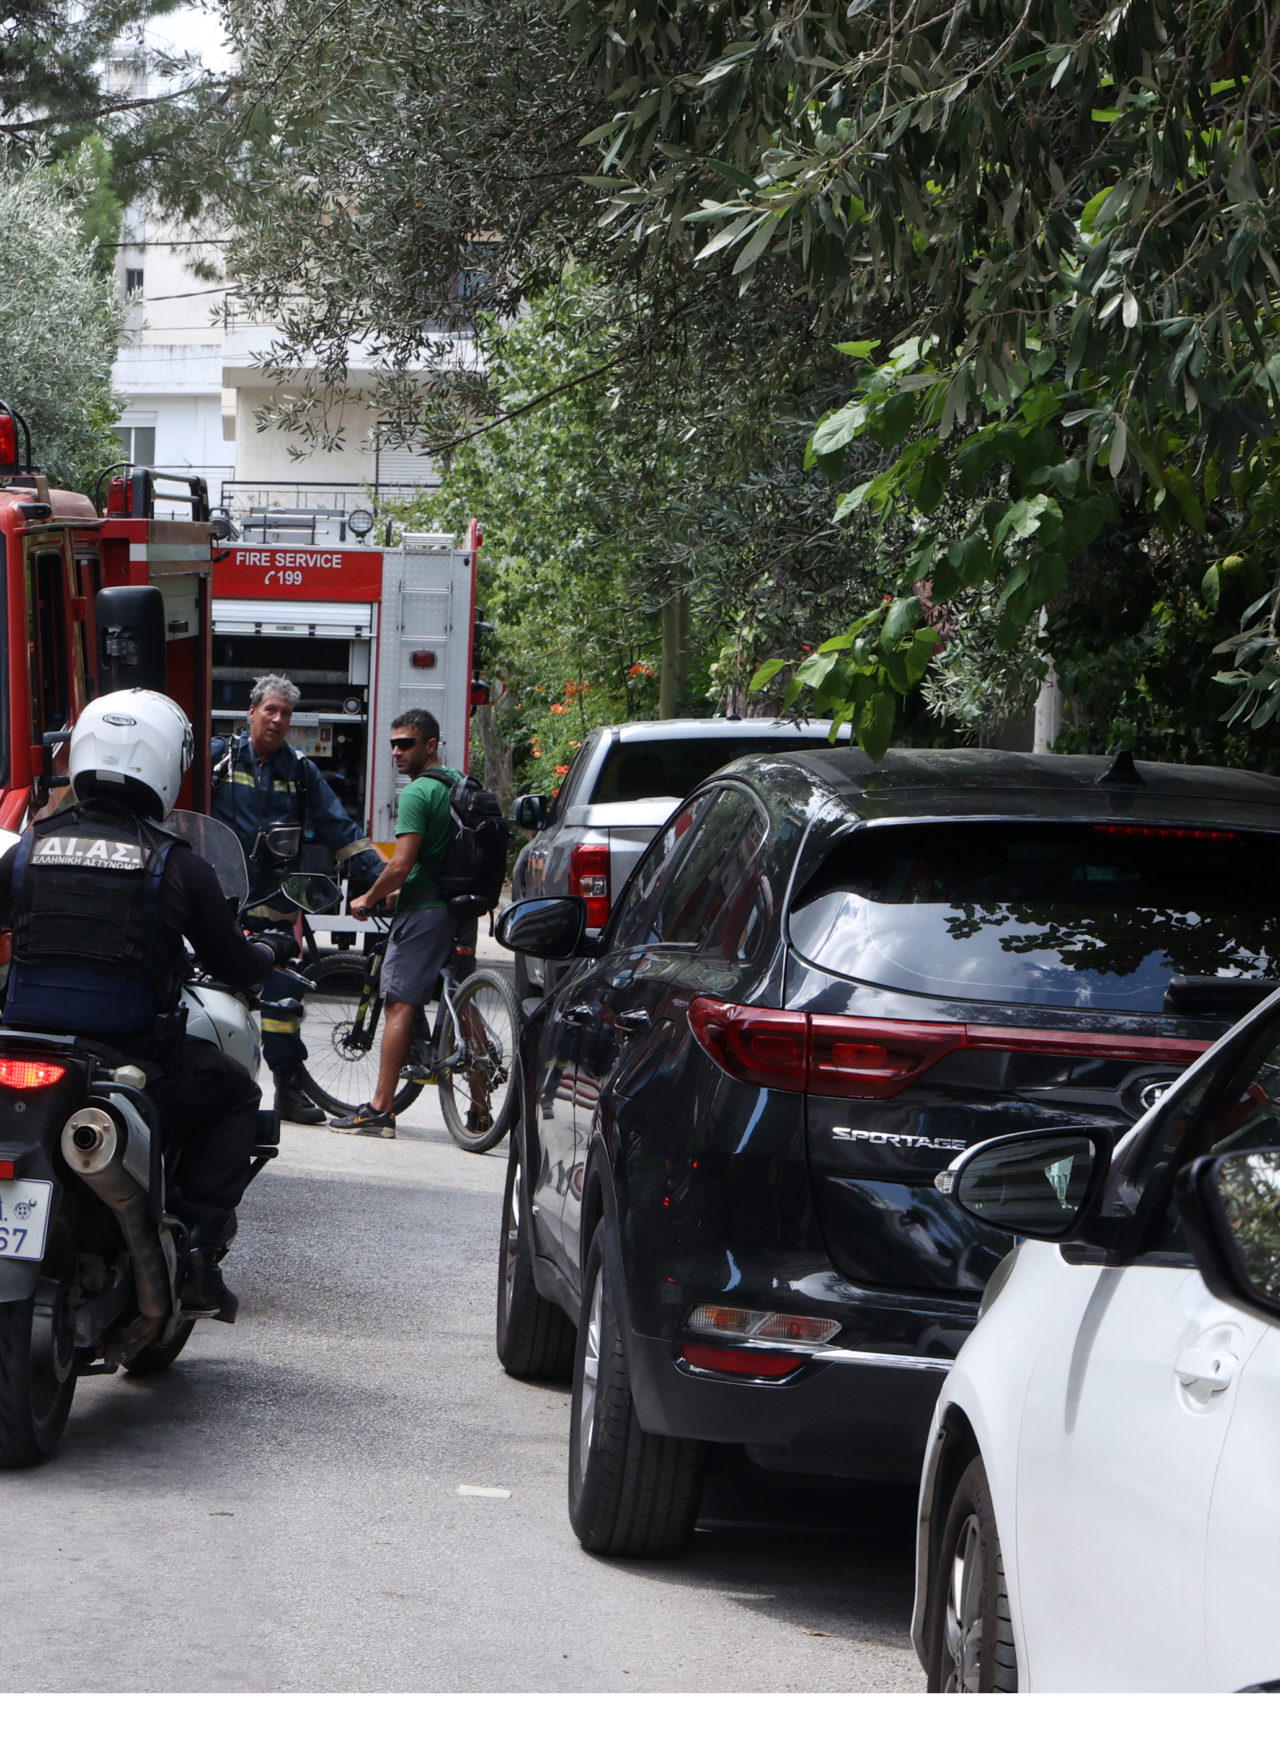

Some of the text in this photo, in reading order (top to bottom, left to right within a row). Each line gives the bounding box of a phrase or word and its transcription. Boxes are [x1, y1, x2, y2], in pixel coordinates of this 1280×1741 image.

[236, 552, 342, 568] FIRE SERVICE
[277, 571, 302, 585] 199
[32, 855, 82, 865] ΕΛΛΗΝΙΚΗ
[832, 1126, 968, 1150] SPORTAGE
